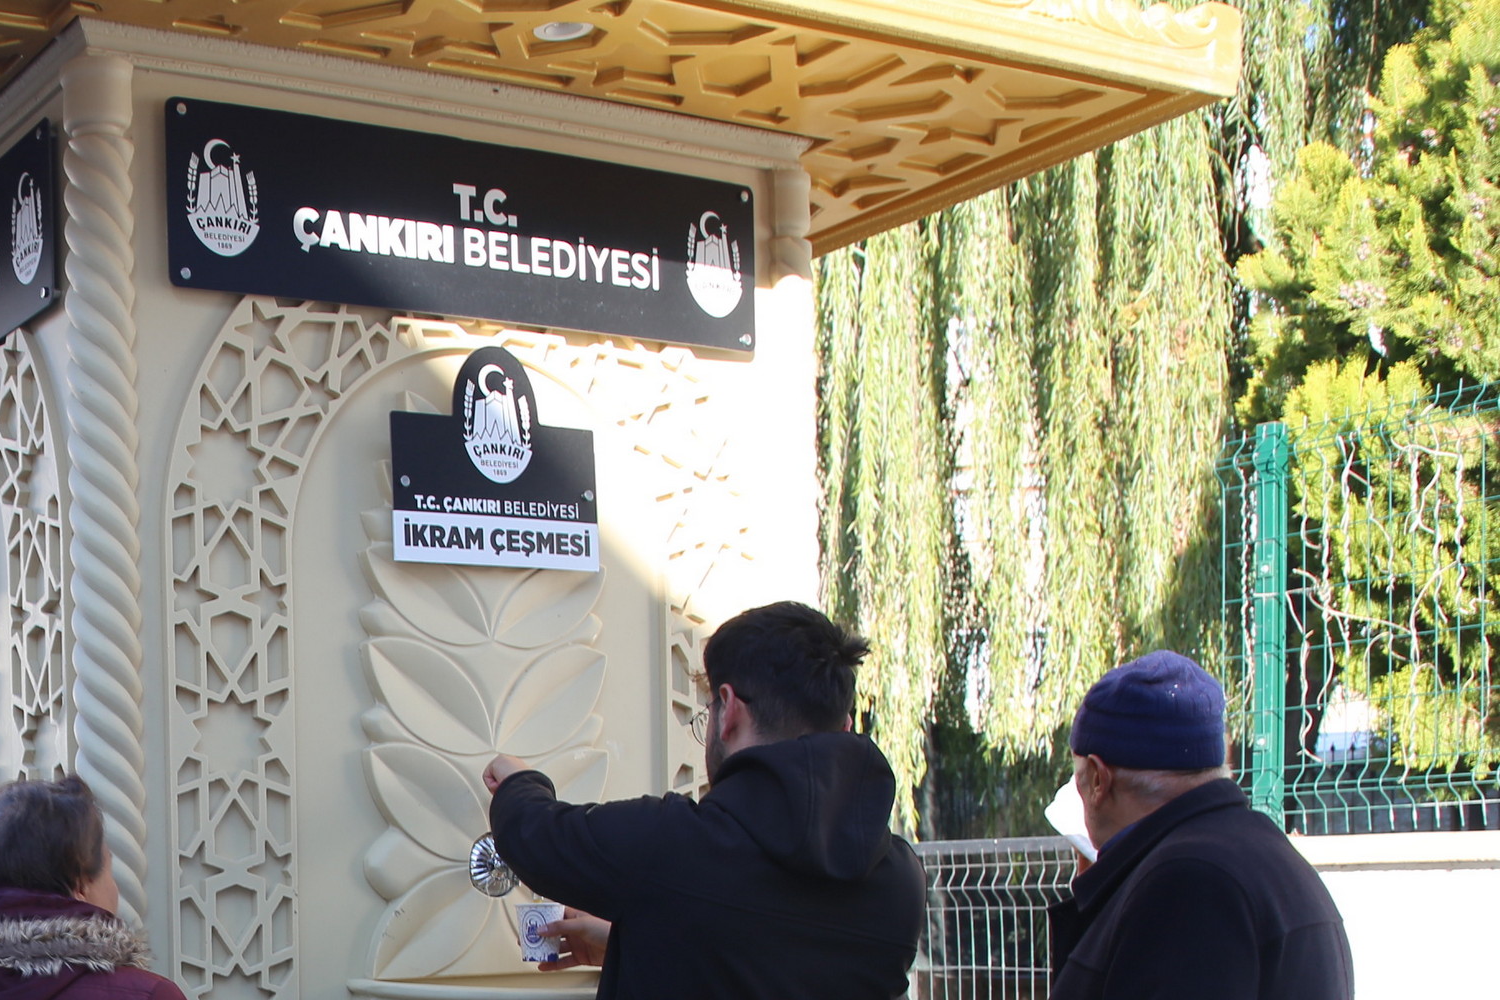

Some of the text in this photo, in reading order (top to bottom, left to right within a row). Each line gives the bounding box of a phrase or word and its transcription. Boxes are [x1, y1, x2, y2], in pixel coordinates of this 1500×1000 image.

[453, 183, 517, 227] T.C.
[196, 216, 252, 235] ÇANKIRI
[204, 232, 245, 242] BELEDİYESİ
[293, 207, 660, 291] ÇANKIRI BELEDİYESİ
[473, 443, 525, 460] ÇANKIRI
[414, 494, 579, 520] T.C. ÇANKIRI BELEDİYESİ
[403, 518, 591, 557] İKRAM ÇEŞMESİ
